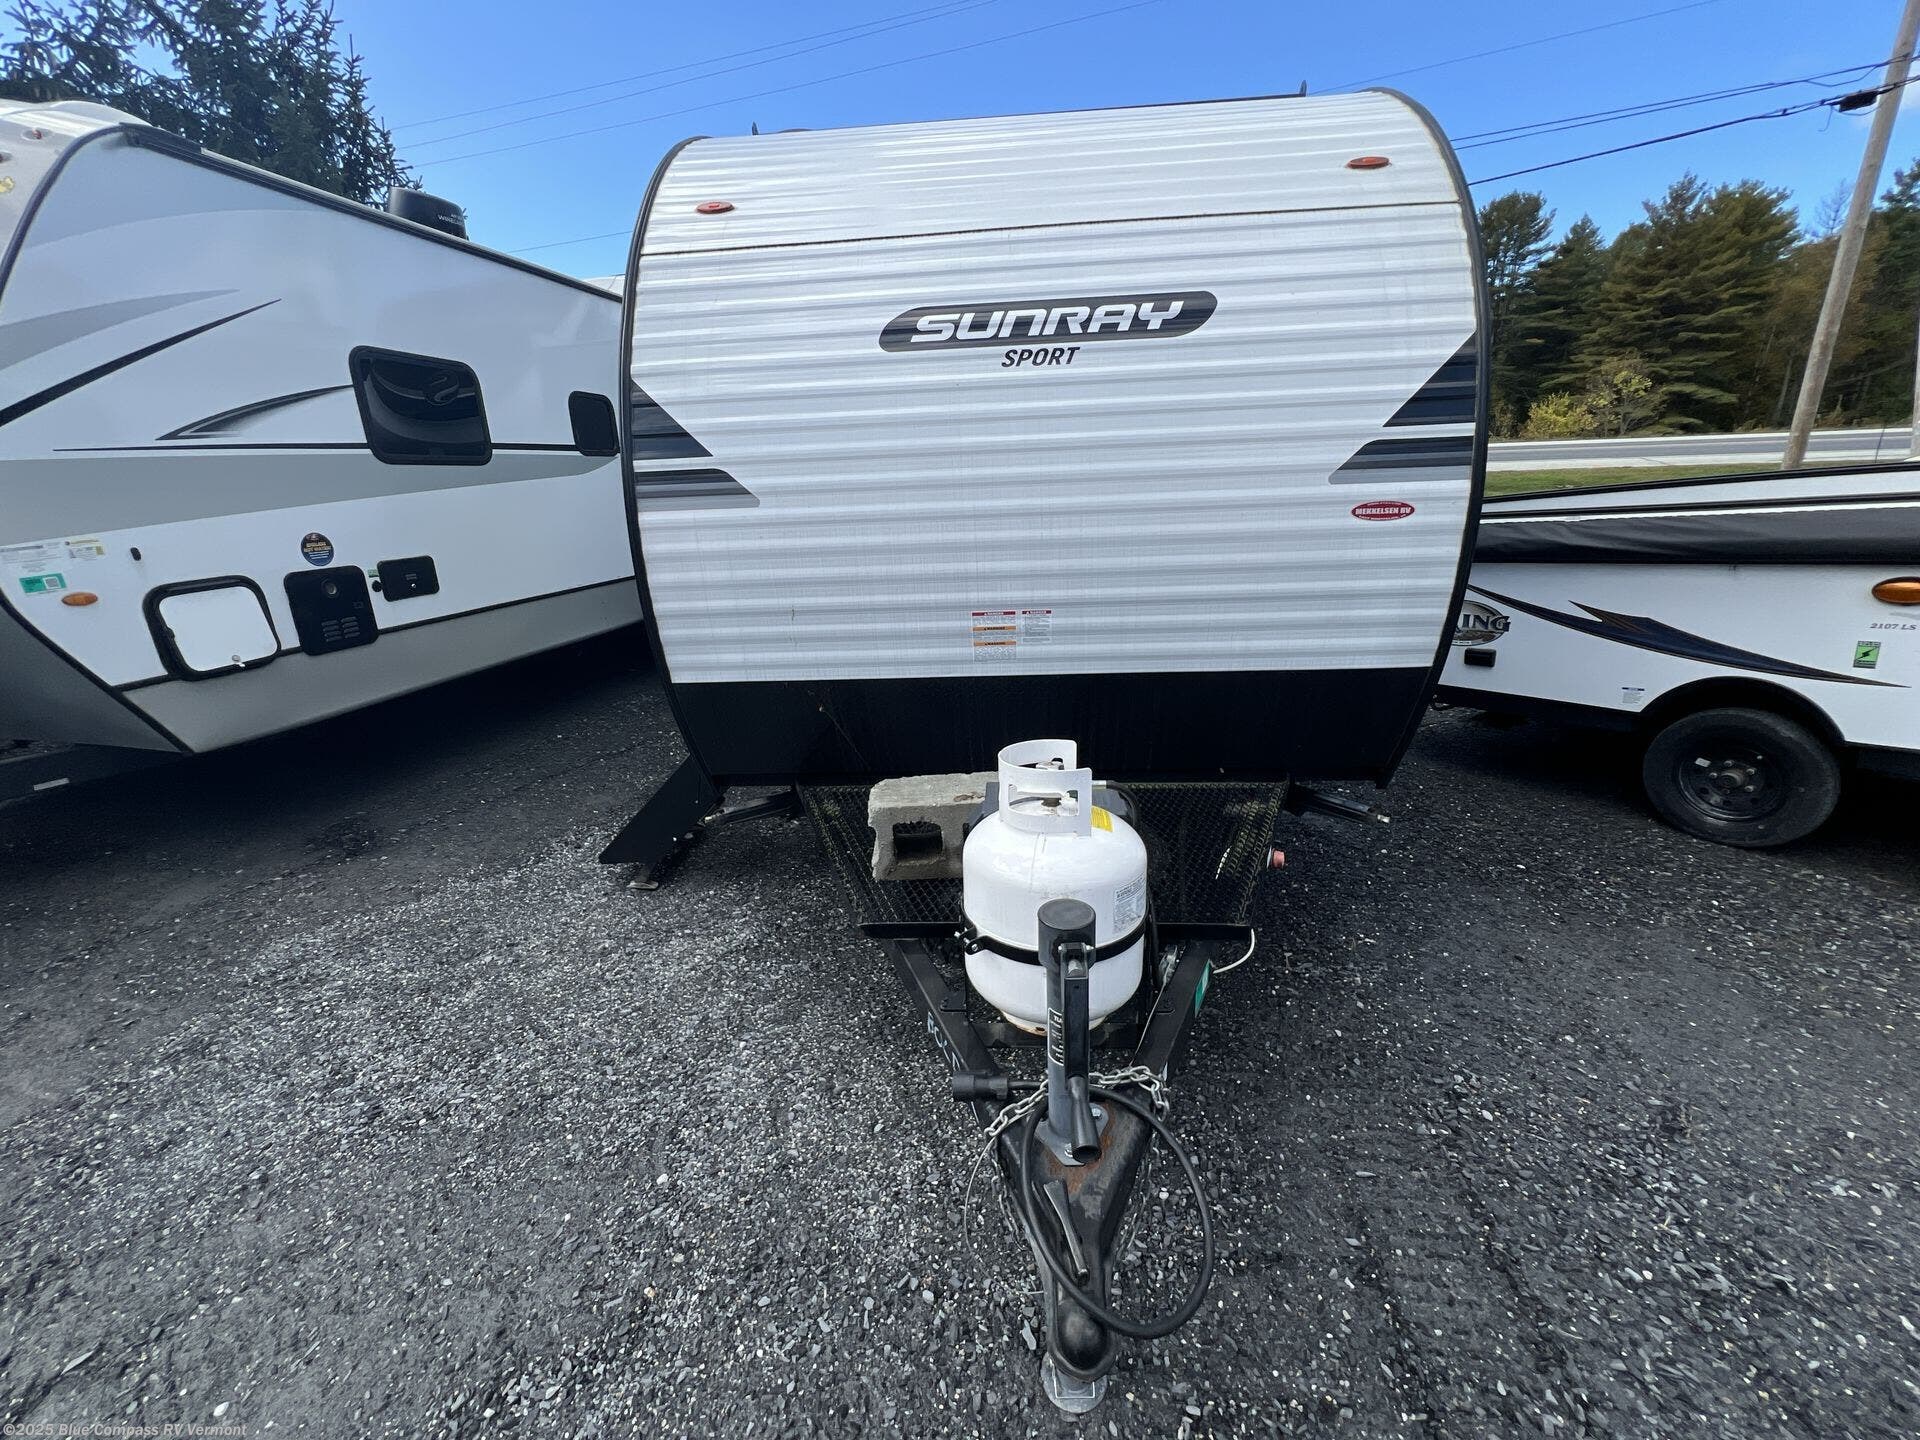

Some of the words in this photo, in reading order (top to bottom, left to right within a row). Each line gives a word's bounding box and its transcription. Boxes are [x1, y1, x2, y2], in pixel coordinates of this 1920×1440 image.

[910, 300, 1185, 344] SUNRAY
[1001, 346, 1081, 368] SPORT
[1355, 507, 1399, 515] MEKKELSEN
[1400, 506, 1412, 515] RV
[1455, 614, 1512, 633] ING
[1870, 622, 1899, 630] 2107
